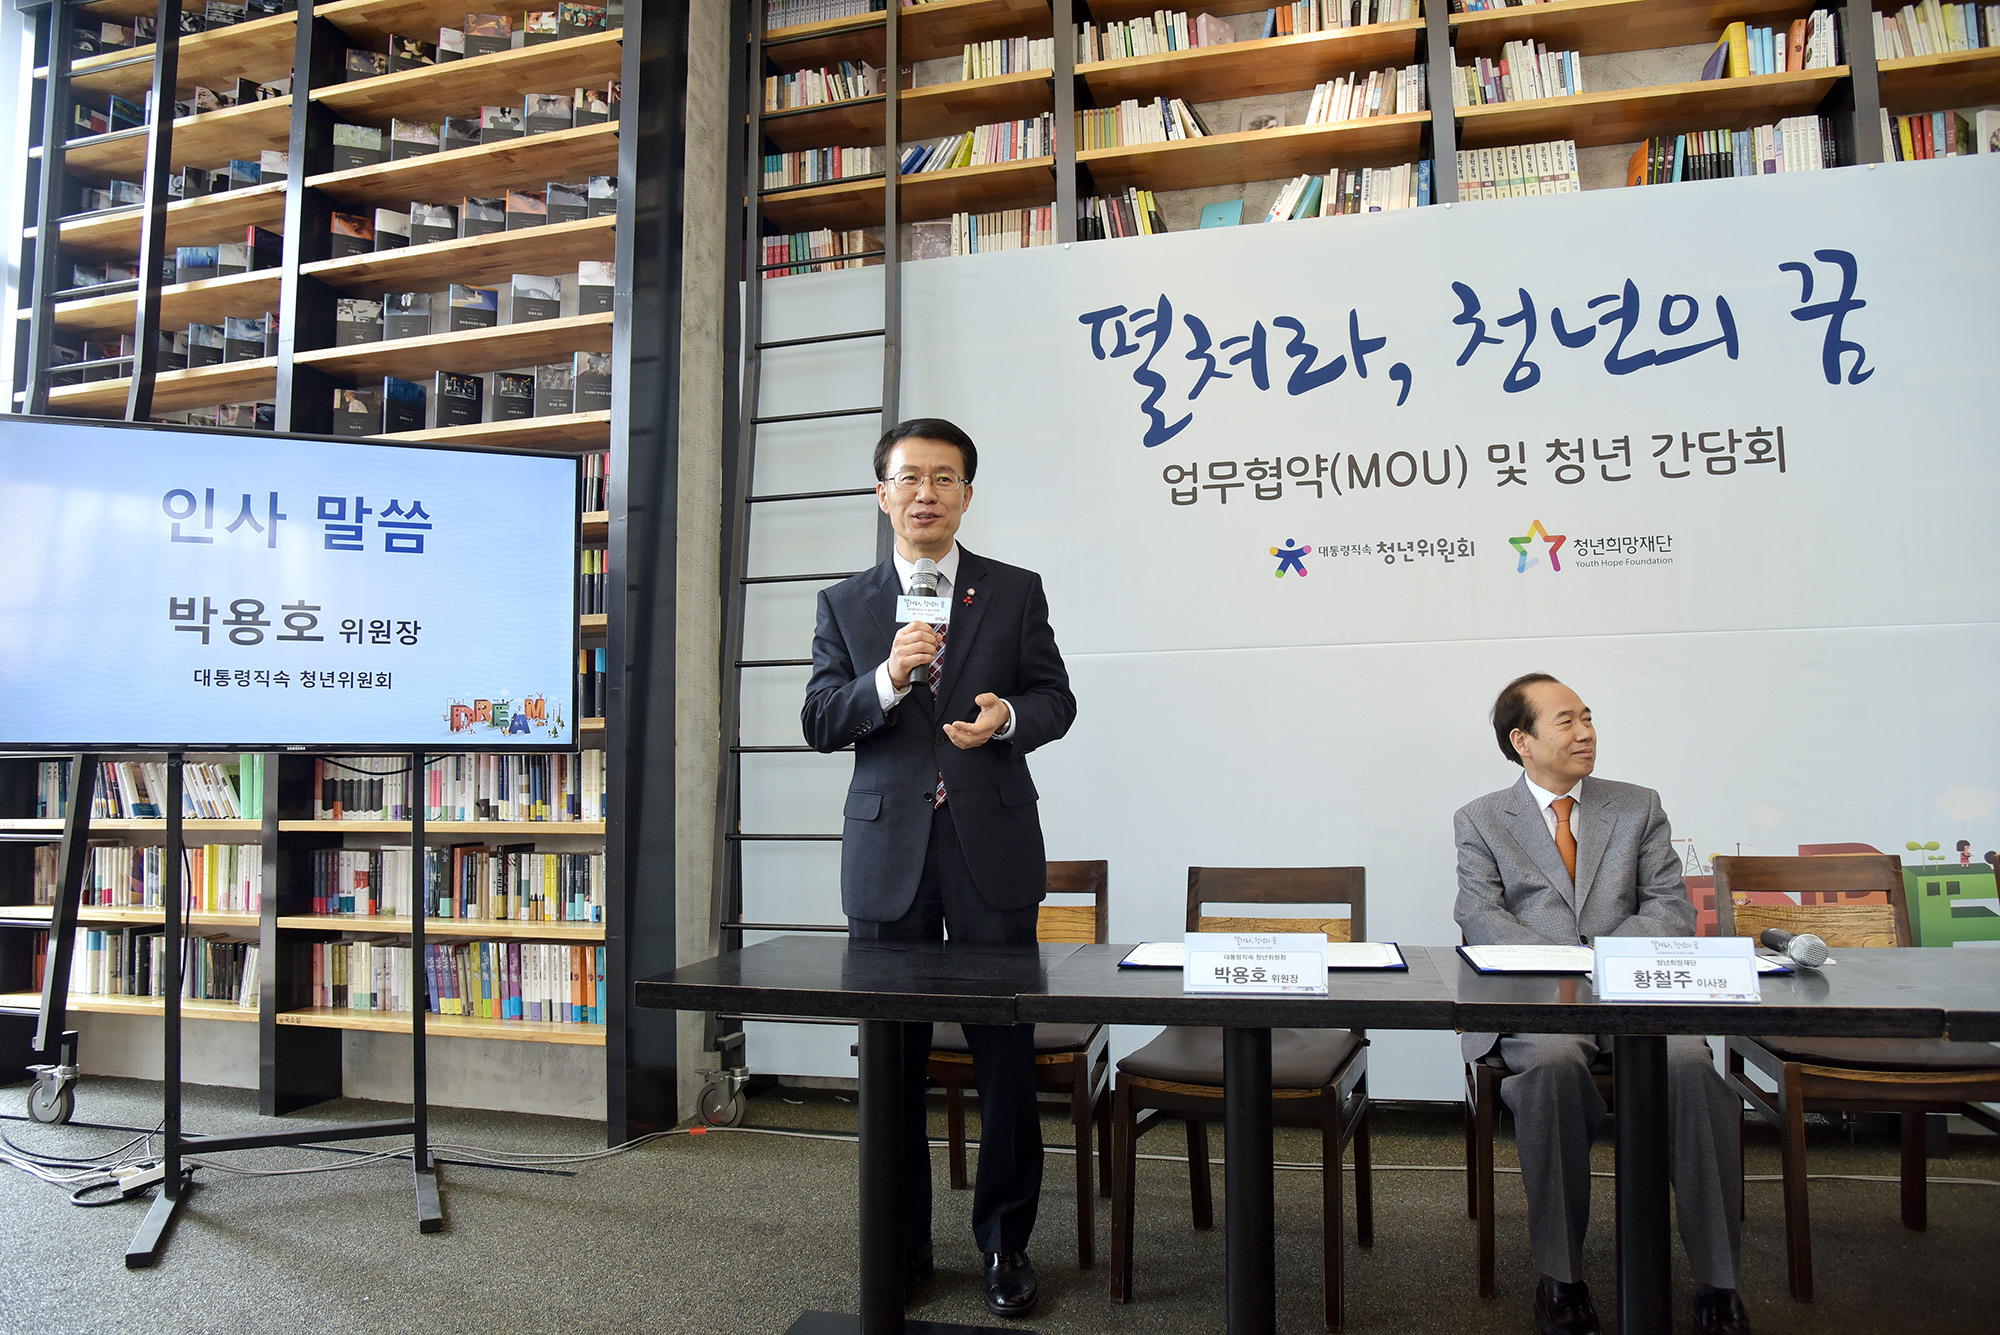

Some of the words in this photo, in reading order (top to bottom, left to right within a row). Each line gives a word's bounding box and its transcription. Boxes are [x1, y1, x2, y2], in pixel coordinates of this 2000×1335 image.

[1077, 292, 1415, 448] 펼쳐라,
[1451, 278, 1740, 394] 청년의
[1778, 249, 1876, 386] 꿈
[1162, 443, 1468, 506] 업무협약(MOU)
[1487, 441, 1528, 488] 및
[1545, 435, 1632, 484] 청년
[1651, 426, 1787, 479] 간담회
[161, 487, 287, 549] 인사
[316, 495, 433, 554] 말씀
[1318, 544, 1373, 558] 대통령직속
[1376, 537, 1475, 564] 청년위원회
[1573, 534, 1673, 557] 청년희망재단
[1575, 559, 1600, 568] Youth
[1601, 558, 1624, 568] Hope
[1625, 557, 1674, 566] Foundation
[168, 596, 325, 646] 박용호
[338, 618, 422, 646] 위원장
[193, 668, 291, 689] 대통령직속
[299, 669, 392, 690] 청년위원회
[449, 698, 546, 735] DREAM
[1214, 966, 1268, 984] 박용호
[1271, 973, 1299, 984] 위원장
[1633, 970, 1693, 989] 황철주
[1696, 978, 1728, 989] 이사장
